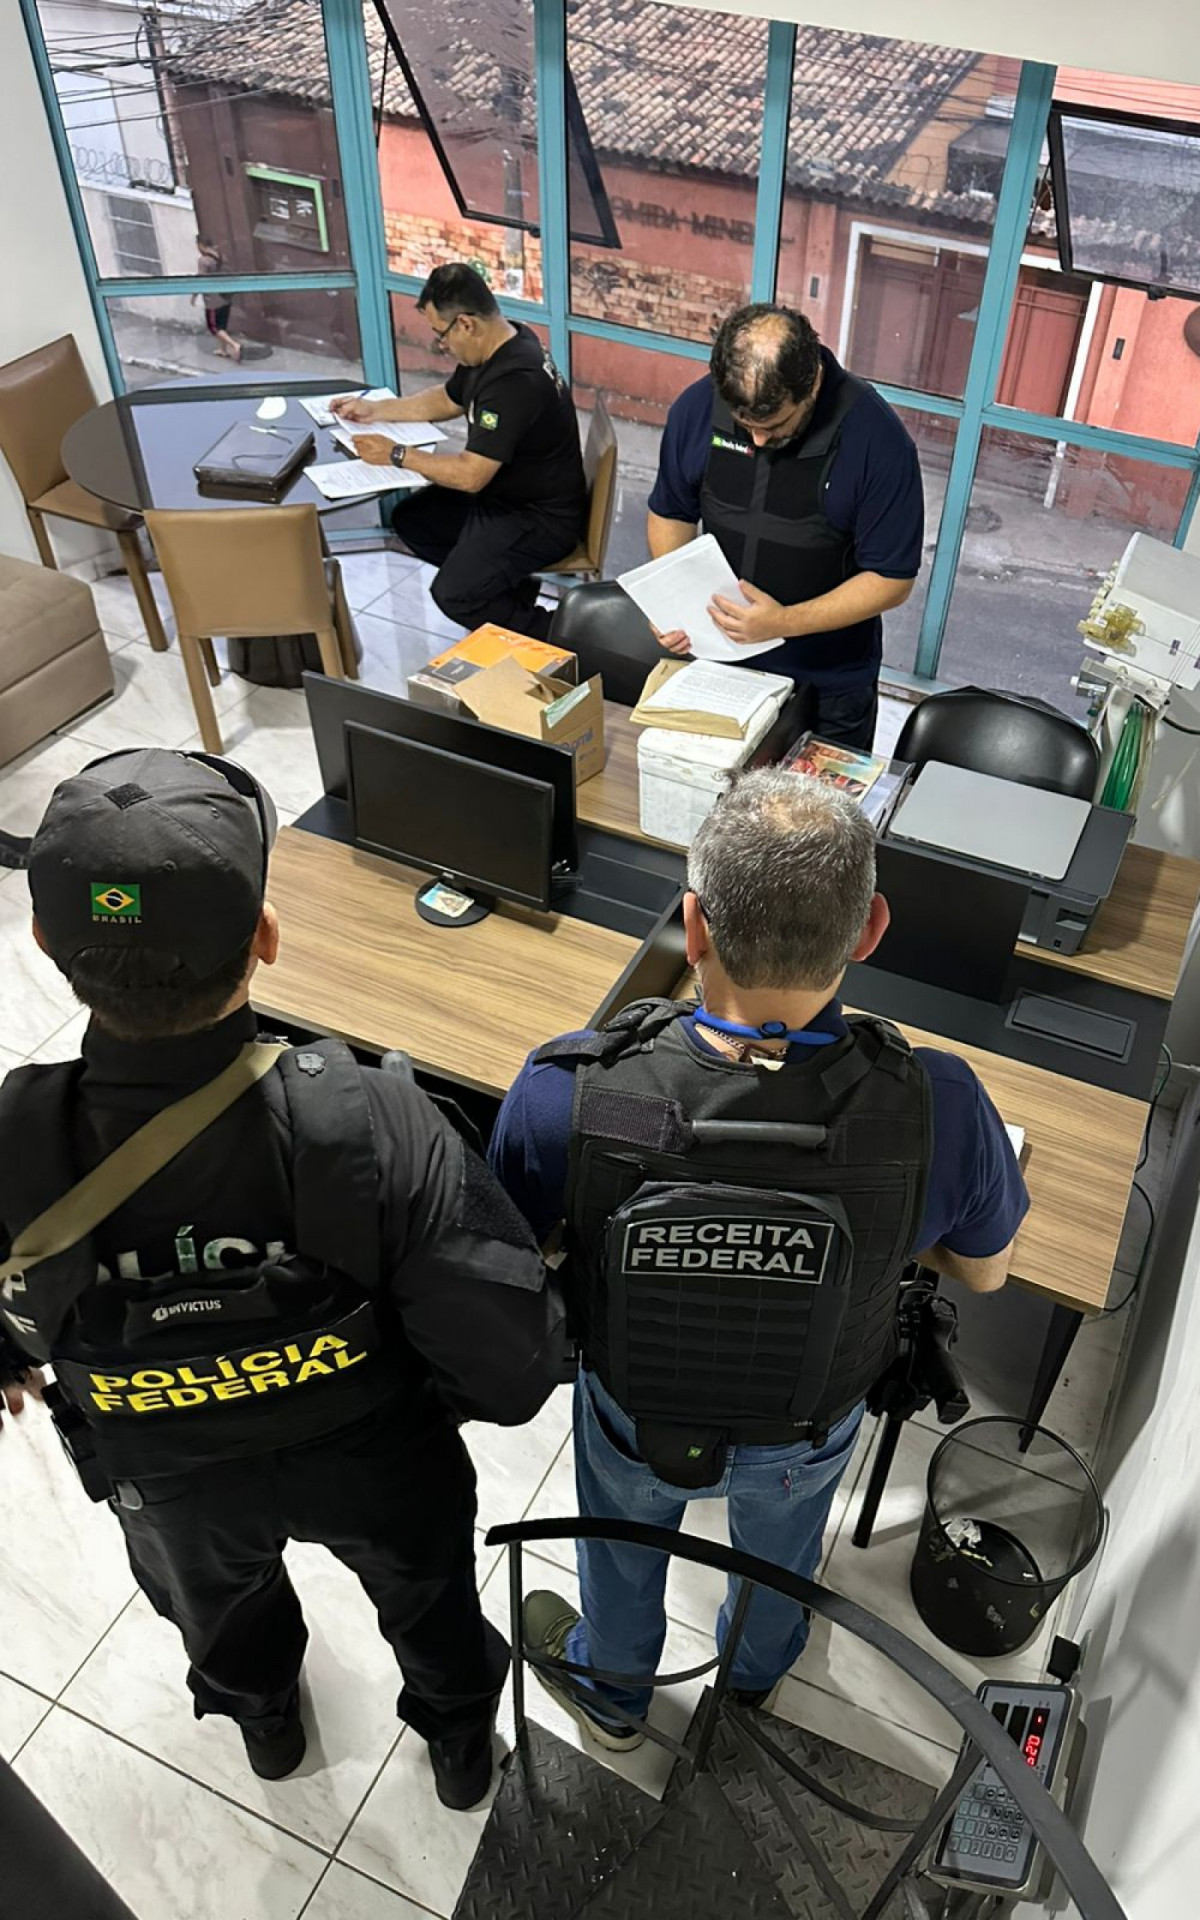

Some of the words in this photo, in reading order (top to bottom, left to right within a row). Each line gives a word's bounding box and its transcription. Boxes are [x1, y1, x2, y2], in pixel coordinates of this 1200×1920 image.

[92, 915, 142, 924] BRASIL
[638, 1223, 815, 1248] RECEITA
[630, 1248, 815, 1275] FEDERAL
[168, 1300, 222, 1315] INVICTUS
[89, 1334, 349, 1393] POLÍCIA
[89, 1350, 368, 1411] FEDERAL
